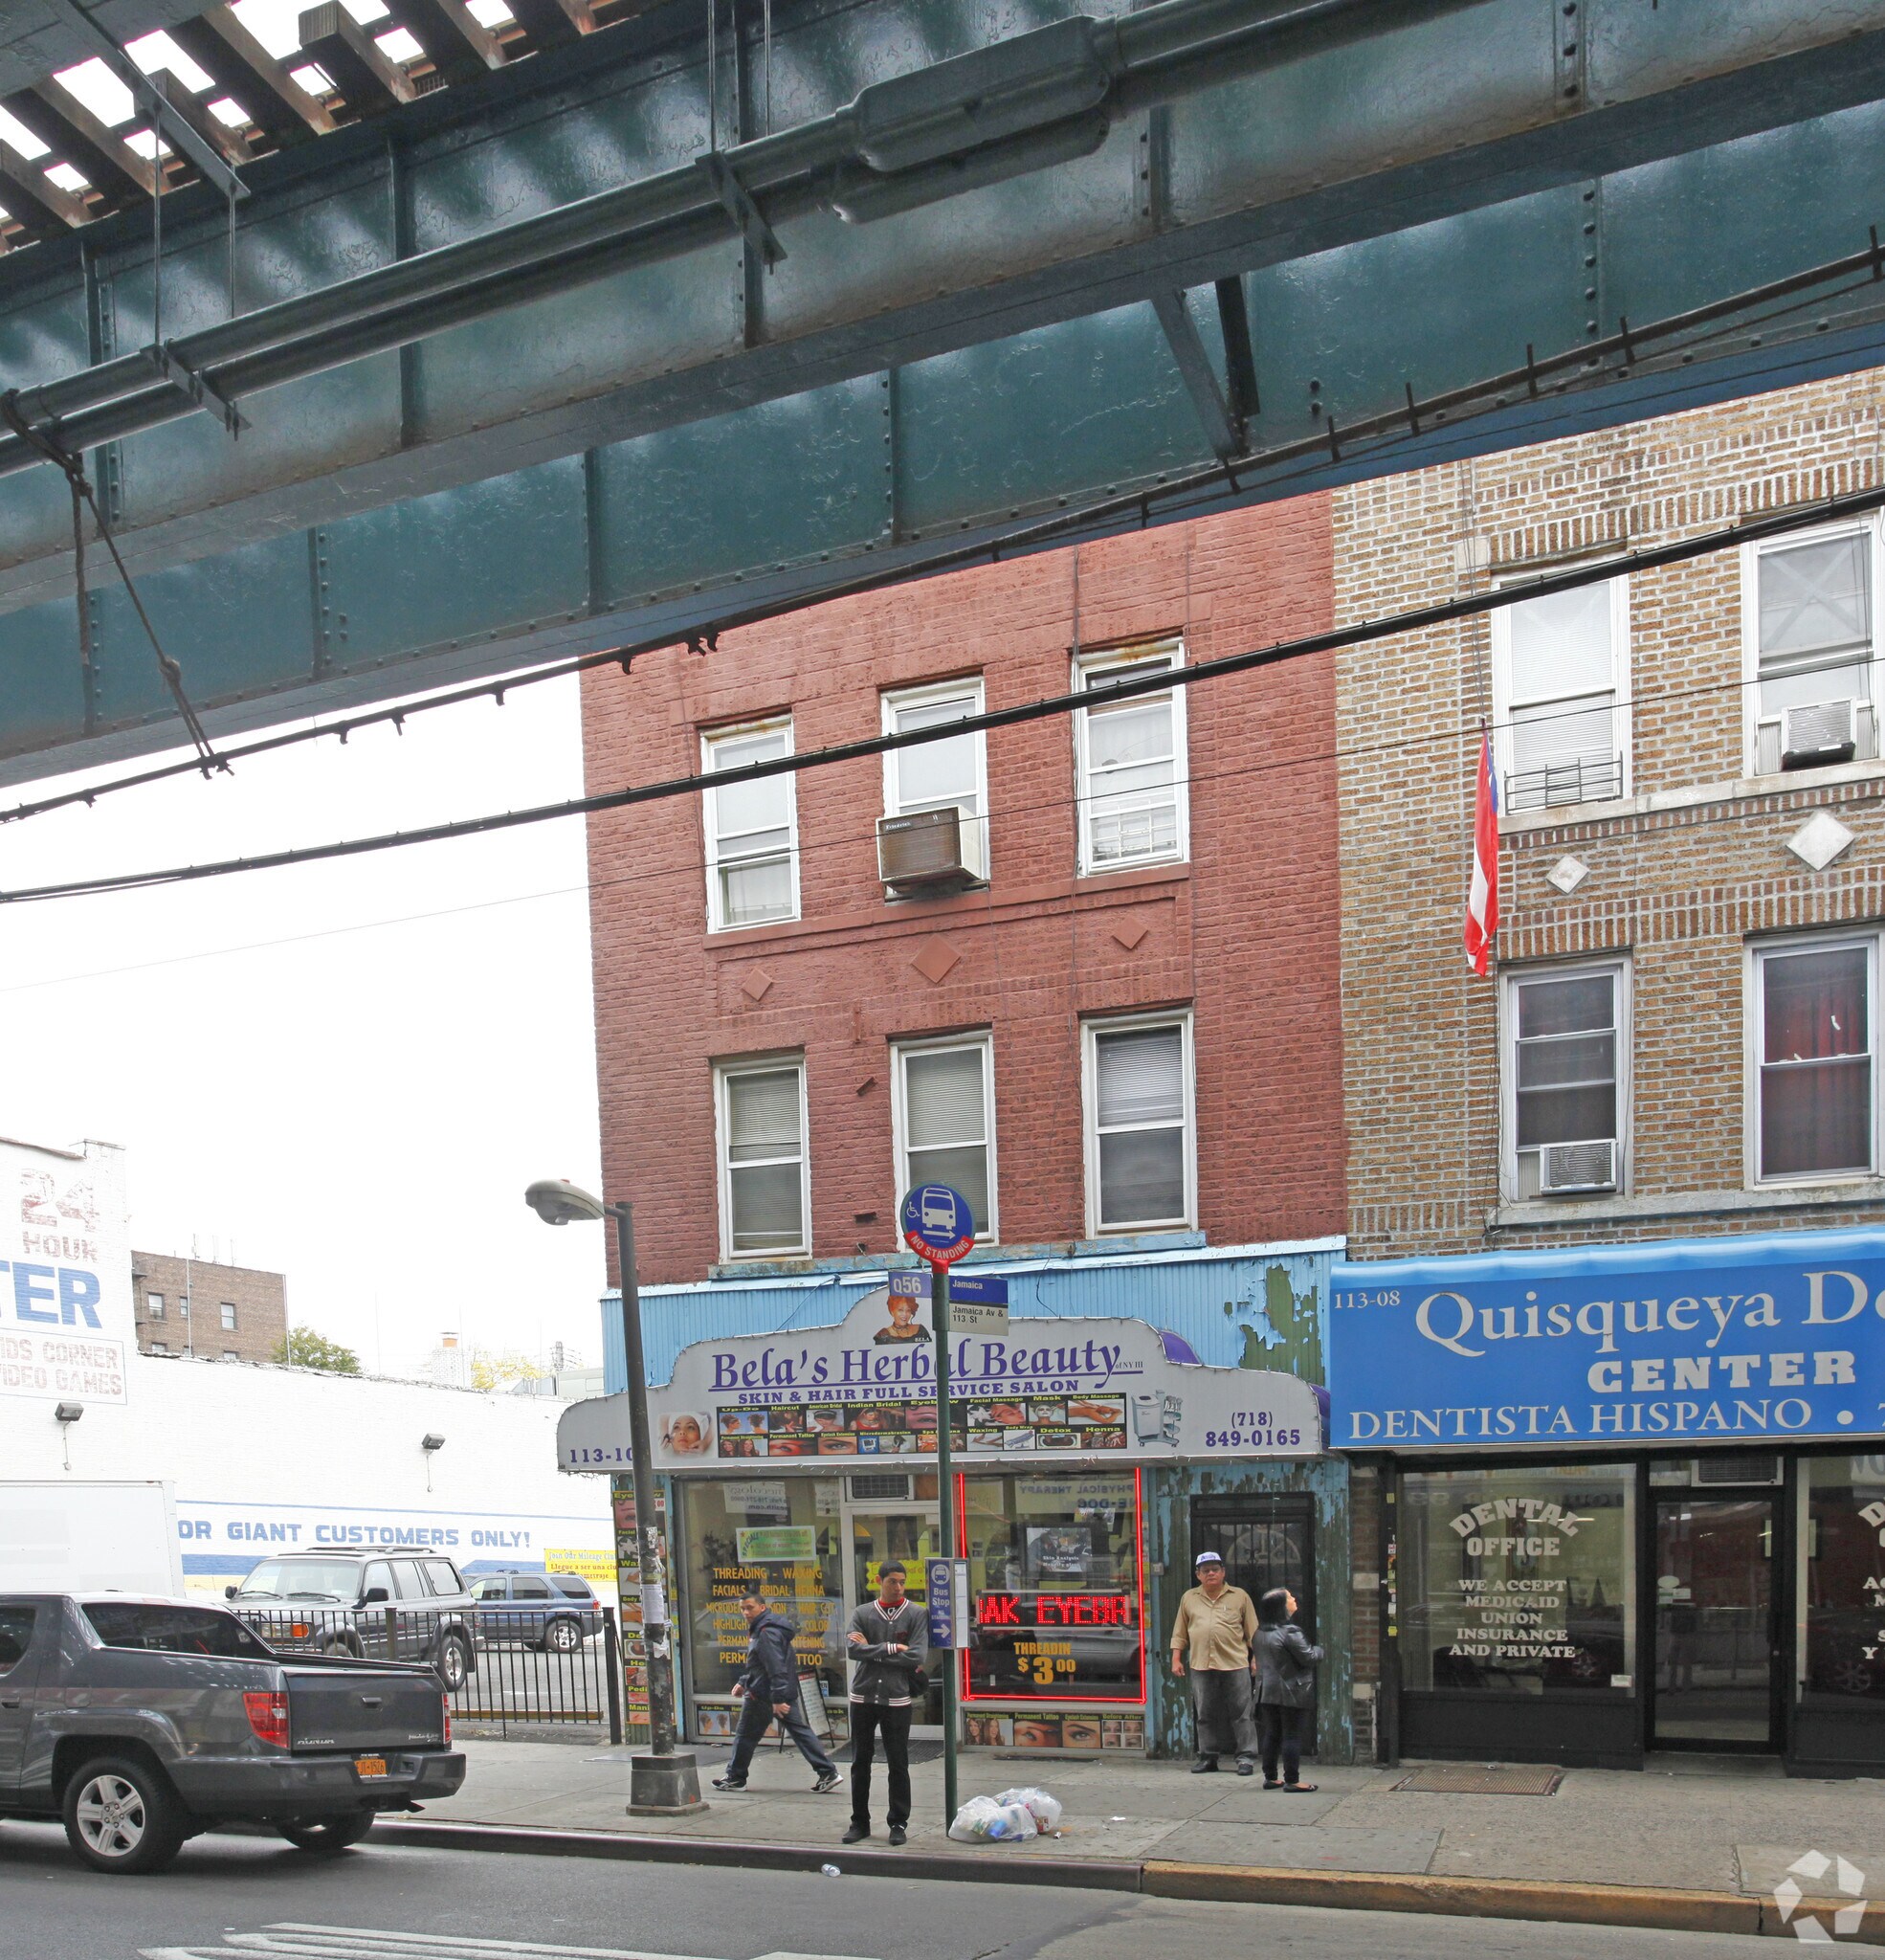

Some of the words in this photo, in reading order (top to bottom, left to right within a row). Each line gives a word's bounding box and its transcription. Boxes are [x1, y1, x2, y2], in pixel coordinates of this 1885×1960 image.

[21, 1169, 100, 1233] 24
[23, 1231, 98, 1263] HOUR
[911, 1235, 924, 1250] NO
[924, 1239, 969, 1259] STANDING
[893, 1276, 921, 1294] Q56
[952, 1280, 984, 1290] Jamaica
[952, 1306, 984, 1316] Jamaica
[986, 1308, 995, 1317] Av
[1334, 1289, 1401, 1309] 113-08
[1415, 1290, 1781, 1357] Quisqueya
[42, 1341, 118, 1370] CORNER
[712, 1348, 829, 1389] Bela's
[980, 1339, 1120, 1389] Beauty
[0, 1364, 47, 1390] IDEO
[55, 1370, 122, 1396] GAMES
[1586, 1350, 1857, 1393] CENTER
[739, 1391, 787, 1405] SKIN
[790, 1391, 811, 1402] &
[816, 1389, 857, 1402] HAIR
[862, 1387, 913, 1401] FULL
[919, 1383, 1004, 1397] SERVICE
[1010, 1380, 1079, 1394] SALON
[1231, 1410, 1274, 1428] (718)
[1350, 1405, 1577, 1439] DENTISTA
[1588, 1397, 1811, 1433] HISPANO
[1206, 1429, 1301, 1448] 849-0165
[1449, 1498, 1580, 1539] DENTAL
[228, 1522, 301, 1544] GIANT
[315, 1525, 459, 1547] CUSTOMERS
[472, 1529, 531, 1549] ONLY!
[1467, 1537, 1560, 1556] OFFICE
[548, 1551, 563, 1561] Join
[578, 1552, 602, 1562] Mileage
[713, 1568, 766, 1579] THREADING
[783, 1569, 822, 1579] WAXING
[713, 1585, 745, 1596] FACIALS
[795, 1586, 825, 1596] HENNA
[933, 1588, 949, 1596] Bus
[1458, 1580, 1490, 1592] WE
[1494, 1579, 1567, 1592] ACCEPT
[932, 1596, 950, 1607] Stop
[980, 1596, 1020, 1623] AK
[1465, 1595, 1560, 1609] MEDICAID
[805, 1619, 830, 1632] COLOR
[1480, 1612, 1542, 1625] UNION
[718, 1635, 749, 1646] PERMAN
[1456, 1628, 1568, 1642] INSURANCE
[1014, 1642, 1072, 1655] THREADIN
[1449, 1644, 1492, 1658] AND
[1495, 1644, 1576, 1659] PRIVATE
[720, 1651, 747, 1663] PERM
[795, 1654, 822, 1665] TTOO
